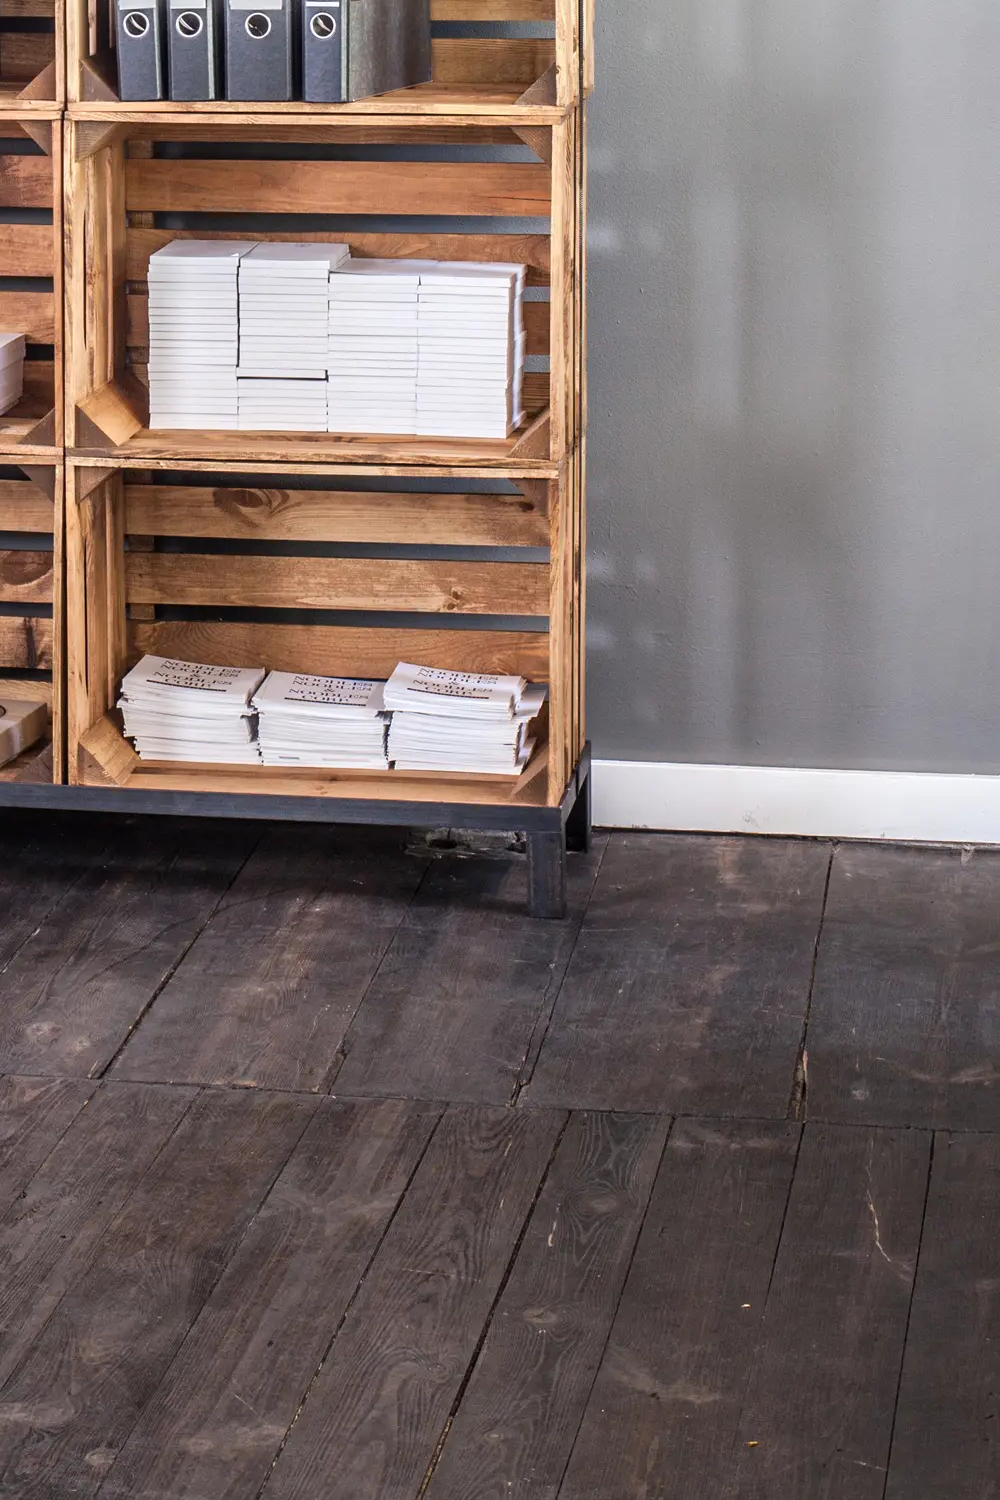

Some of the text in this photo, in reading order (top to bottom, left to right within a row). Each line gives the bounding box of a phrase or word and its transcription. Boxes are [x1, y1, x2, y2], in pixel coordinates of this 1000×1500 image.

[160, 664, 239, 678] NOODLES
[164, 660, 242, 674] NOODLES
[153, 671, 233, 685] NOODLES
[417, 672, 497, 684] NOODLES
[420, 668, 498, 680] NOODLES
[292, 680, 372, 691] NOODLES
[295, 675, 373, 687] NOODLES
[412, 679, 493, 692] NOODLES
[288, 688, 369, 699] NOODLES
